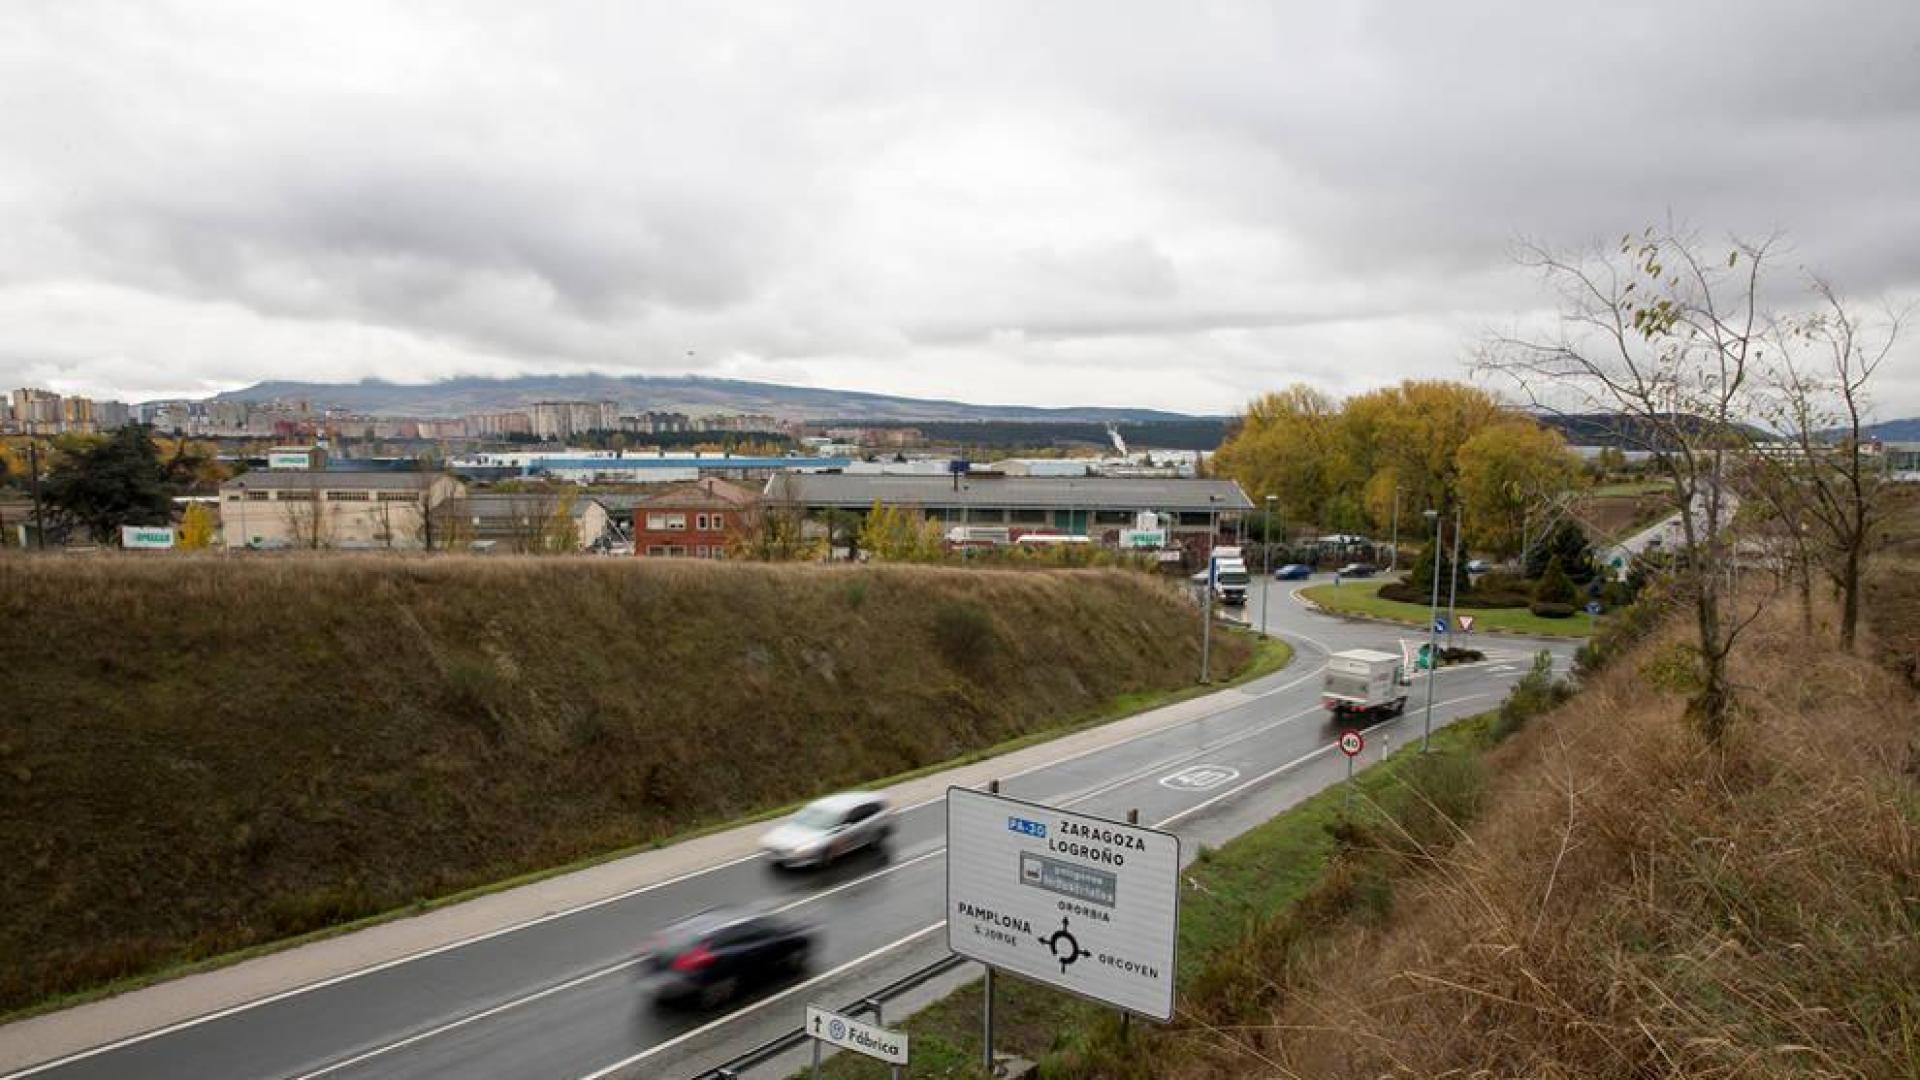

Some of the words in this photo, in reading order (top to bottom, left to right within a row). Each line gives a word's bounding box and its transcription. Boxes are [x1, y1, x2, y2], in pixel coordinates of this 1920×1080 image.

[1344, 738, 1358, 748] 40
[1060, 820, 1146, 852] ZARAGOZA
[1048, 838, 1125, 866] LOGROÑO
[958, 901, 1032, 935] PAMPLONA
[1098, 953, 1159, 979] ORCOYEN
